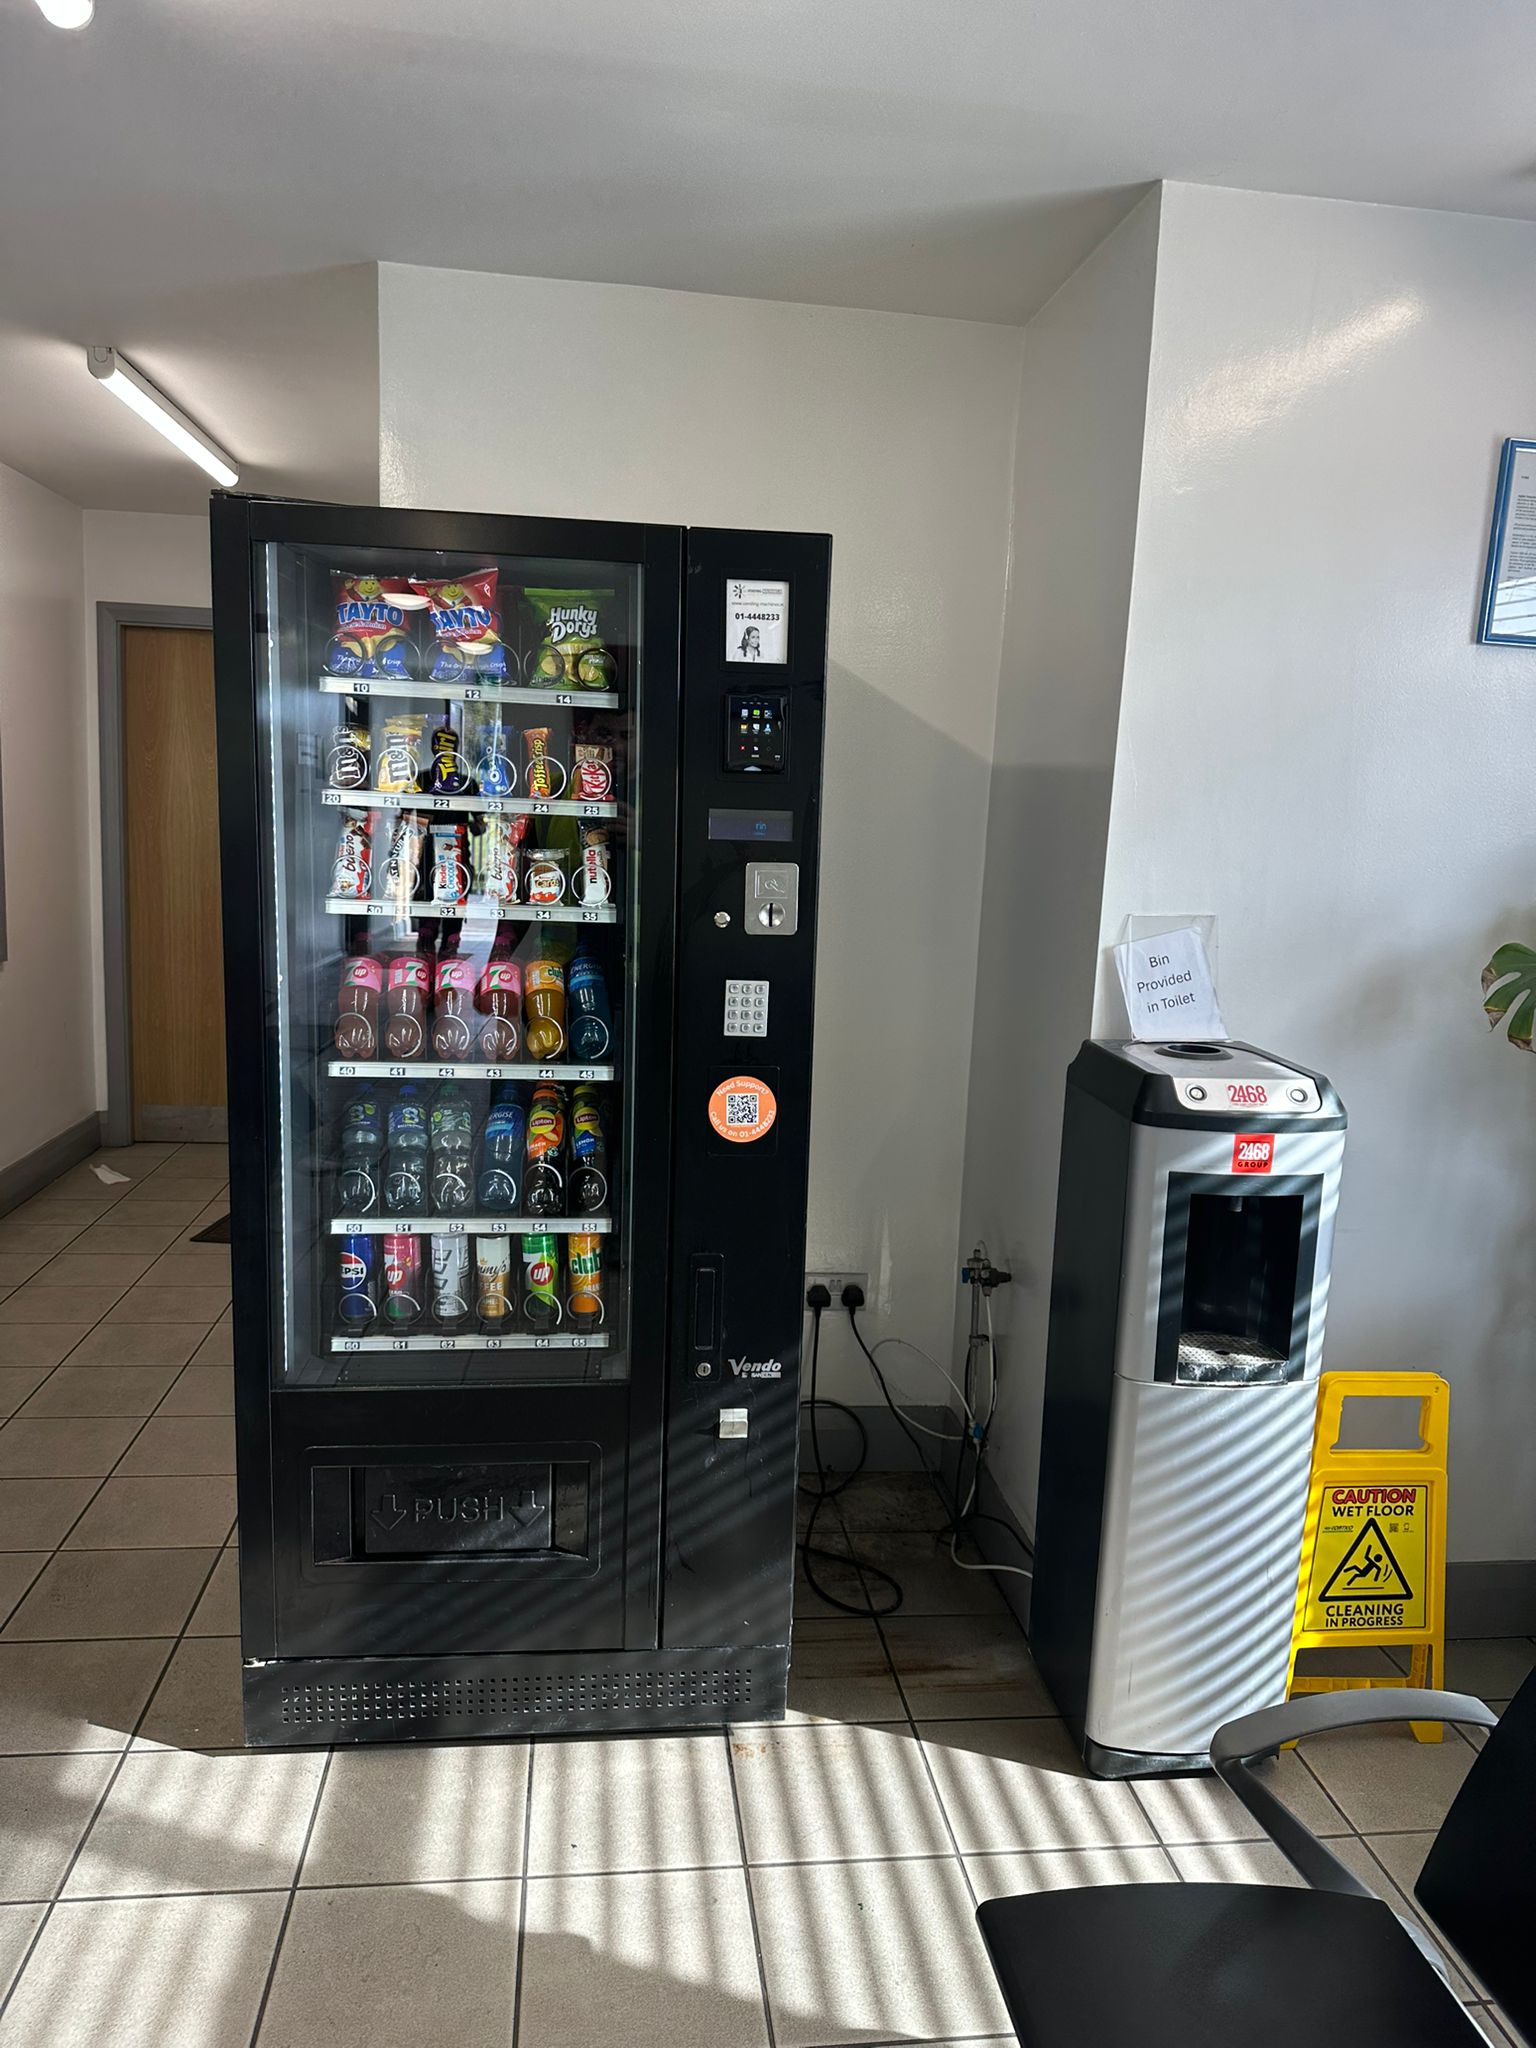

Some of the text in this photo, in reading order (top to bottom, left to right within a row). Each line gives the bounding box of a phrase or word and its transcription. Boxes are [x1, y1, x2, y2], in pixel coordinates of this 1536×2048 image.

[337, 602, 404, 627] TAYTO
[430, 605, 492, 633] TAYTO
[546, 605, 598, 626] Hunky
[735, 613, 780, 621] 01-4448233
[550, 621, 598, 643] Dorys
[355, 684, 369, 692] 10
[466, 690, 480, 699] 12
[557, 695, 571, 704] 14
[437, 732, 458, 782] Twirl
[533, 759, 548, 791] Toffee
[326, 795, 340, 803] 20
[384, 797, 399, 806] 21
[435, 800, 449, 808] 22
[489, 802, 503, 810] 23
[534, 805, 548, 813] 24
[585, 807, 599, 815] 25
[342, 834, 356, 872] bueno
[586, 849, 597, 884] nutella
[368, 906, 382, 914] 30
[441, 908, 455, 916] 32
[491, 910, 505, 918] 33
[536, 911, 550, 920] 34
[583, 913, 597, 921] 35
[1149, 954, 1170, 968] Bin
[1137, 970, 1192, 993] Provided
[1147, 993, 1196, 1013] in Toilet
[340, 1067, 355, 1075] 40
[390, 1068, 405, 1076] 41
[439, 1069, 454, 1077] 42
[487, 1069, 501, 1077] 43
[540, 1070, 554, 1078] 44
[580, 1071, 594, 1079] 45
[716, 1081, 736, 1096] Need
[1227, 1084, 1268, 1104] 2468
[532, 1118, 553, 1126] Lipton
[576, 1114, 598, 1123] Lipton
[711, 1111, 721, 1126] Call
[1237, 1142, 1271, 1161] 2468
[347, 1224, 361, 1232] 50
[396, 1224, 410, 1232] 51
[450, 1223, 464, 1232] 52
[492, 1223, 506, 1232] 53
[533, 1223, 547, 1232] 54
[583, 1223, 596, 1231] 55
[344, 1266, 364, 1276] PSI
[345, 1342, 359, 1350] 60
[394, 1341, 407, 1349] 61
[441, 1340, 455, 1349] 62
[488, 1339, 501, 1348] 63
[536, 1339, 549, 1347] 64
[573, 1338, 586, 1347] 65
[728, 1356, 782, 1376] Vendo
[1331, 1488, 1417, 1504] CAUTION
[415, 1496, 504, 1522] PUSH
[1332, 1505, 1414, 1517] WET FLOOR
[1326, 1603, 1404, 1617] CLEANING
[1325, 1616, 1403, 1628] IN PROGRESS
